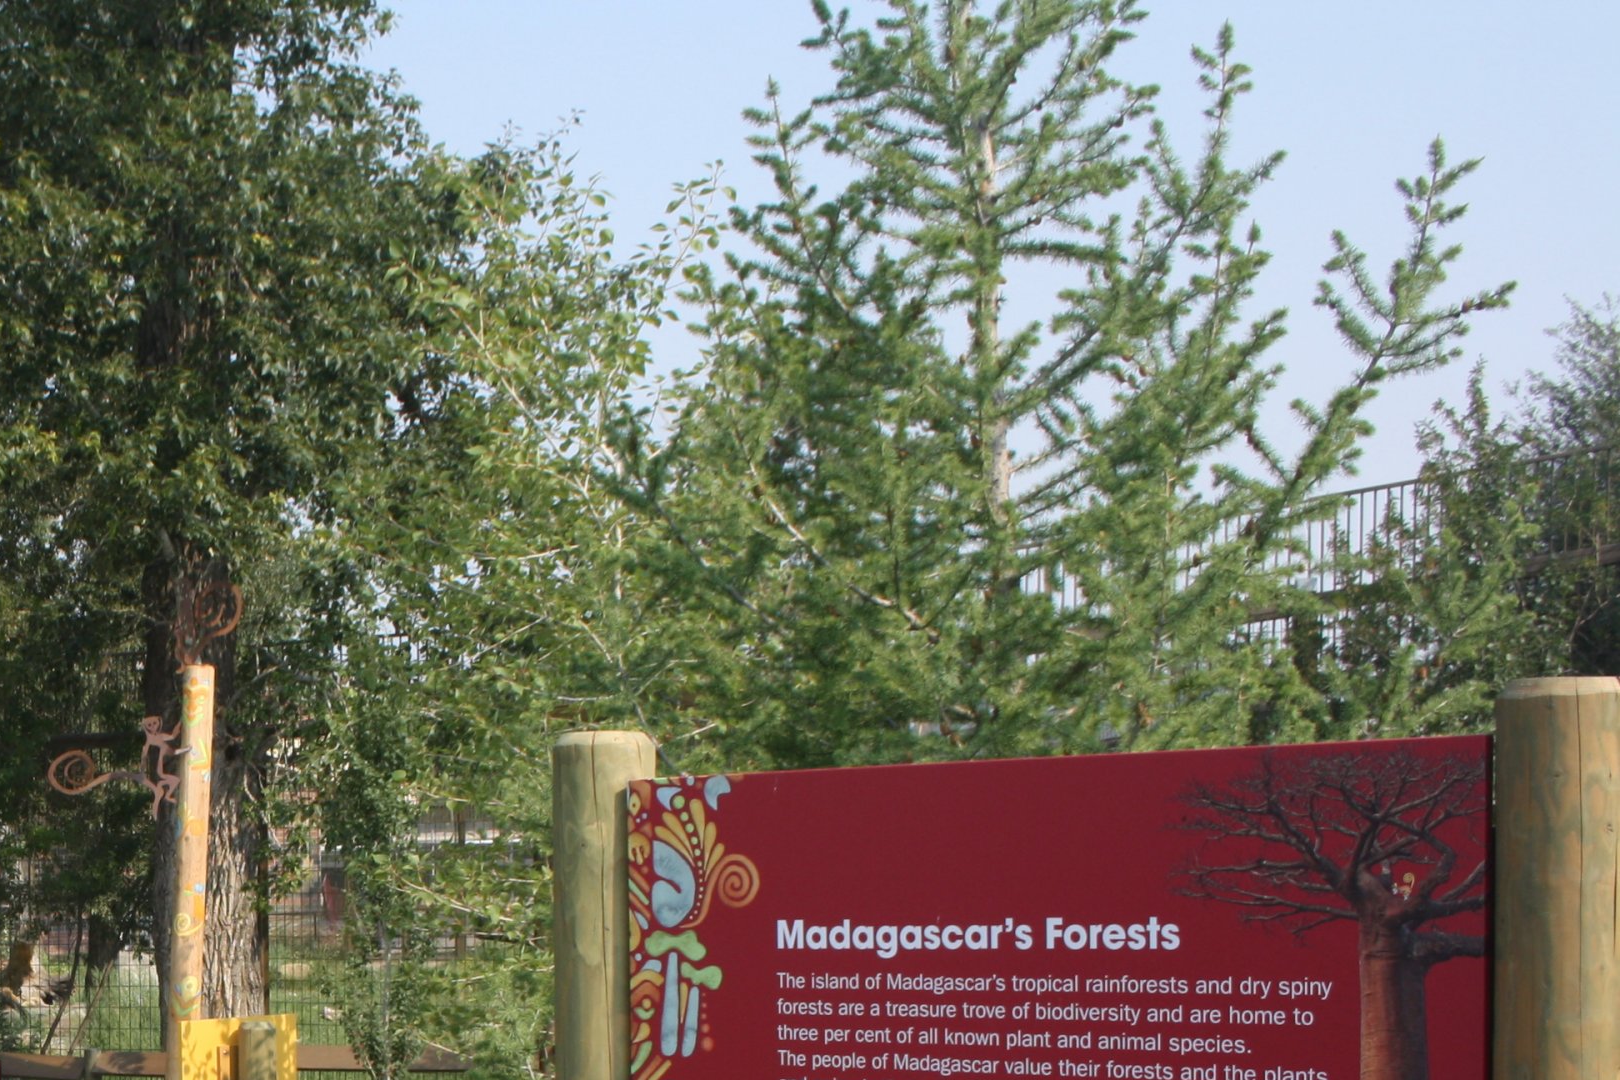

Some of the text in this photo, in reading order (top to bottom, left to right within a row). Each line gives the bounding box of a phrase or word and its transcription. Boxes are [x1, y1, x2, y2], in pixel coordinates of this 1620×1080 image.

[776, 916, 1181, 959] Madagascar's Forests
[776, 971, 1333, 1001] The island of Madagascar's tropical rainforests and dry spiny
[776, 997, 1314, 1026] forests are a treasure trove of biodiversity and are home to
[776, 1024, 1252, 1056] three per cent of all known plant and animal species.
[777, 1049, 807, 1067] The
[812, 1052, 867, 1072] people
[871, 1052, 889, 1070] of
[893, 1053, 1000, 1077] Madagascar
[1004, 1057, 1053, 1076] value
[1057, 1058, 1101, 1078] their
[1105, 1059, 1174, 1080] forests
